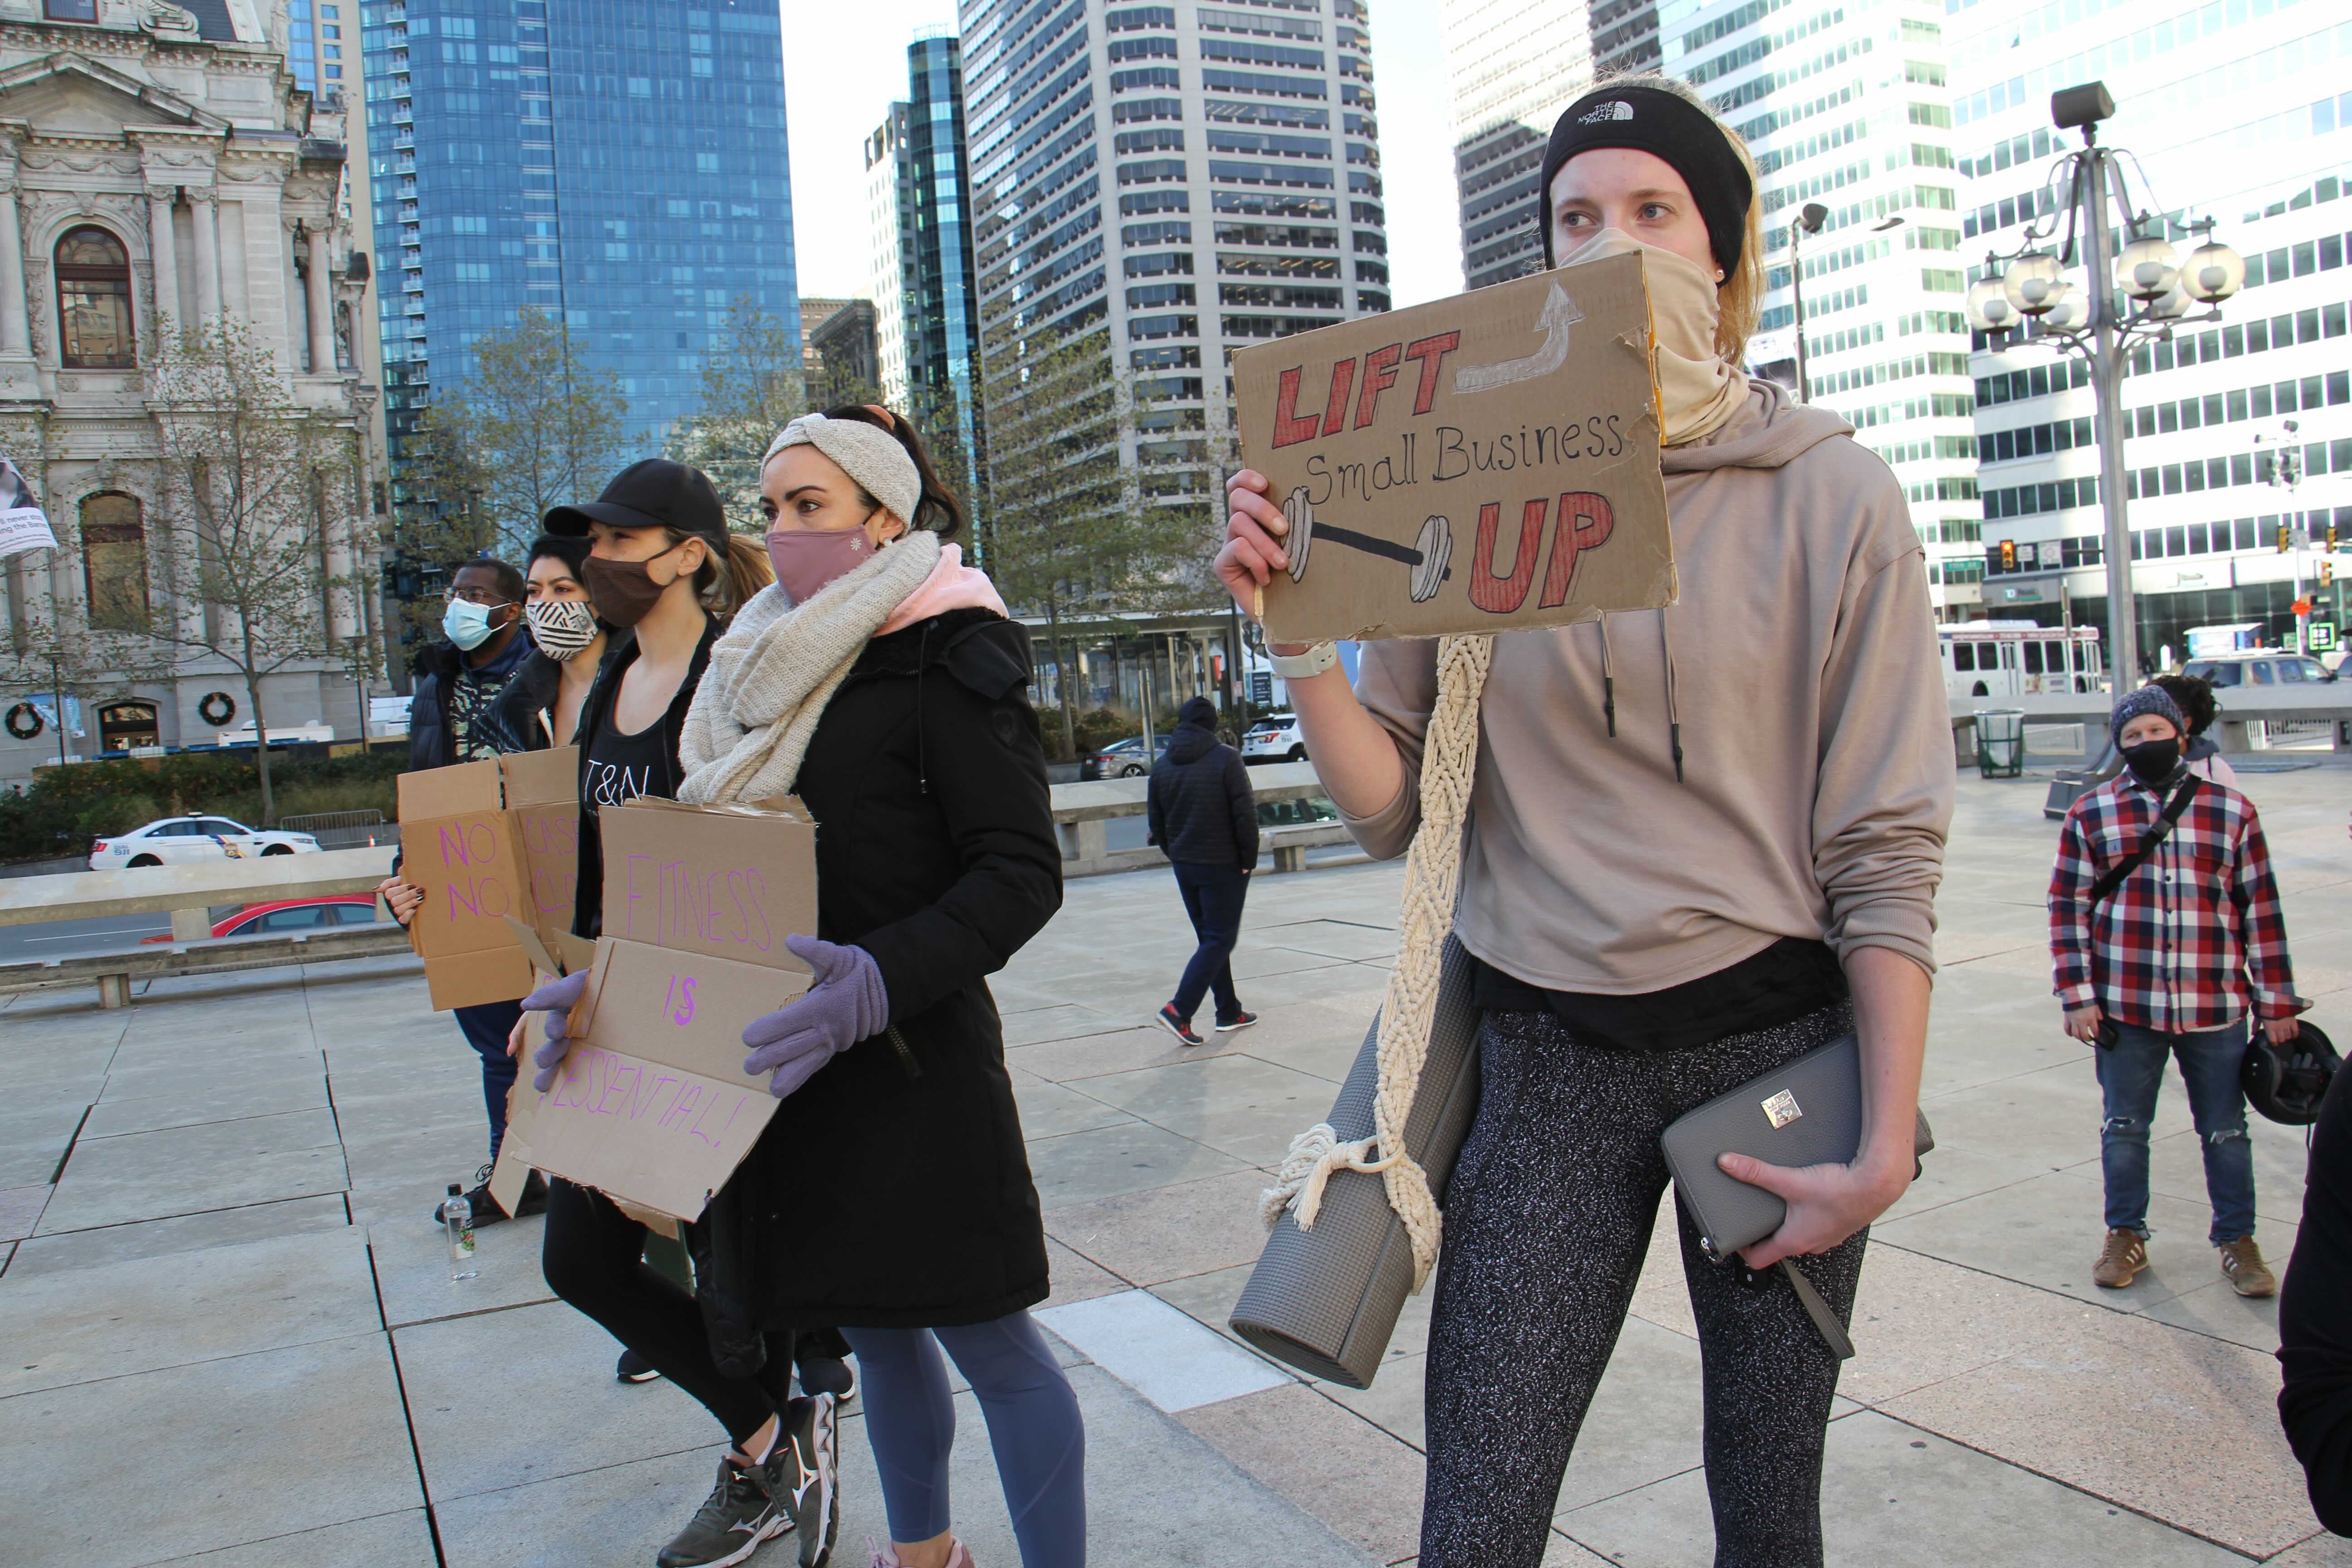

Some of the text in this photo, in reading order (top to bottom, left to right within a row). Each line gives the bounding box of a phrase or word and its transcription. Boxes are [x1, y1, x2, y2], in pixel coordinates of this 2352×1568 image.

[1577, 107, 1614, 124] NORTH
[1585, 113, 1612, 126] FACE
[1594, 101, 1615, 112] THE
[1272, 330, 1461, 450] LIFT
[1303, 415, 1623, 505] Small Business
[1468, 491, 1615, 614] UP
[585, 760, 649, 807] T&N
[439, 821, 496, 868] NO
[447, 876, 510, 922] NO
[627, 854, 772, 951] FITNESS
[662, 974, 697, 1026] IS
[553, 1050, 748, 1148] ESSENTIAL!
